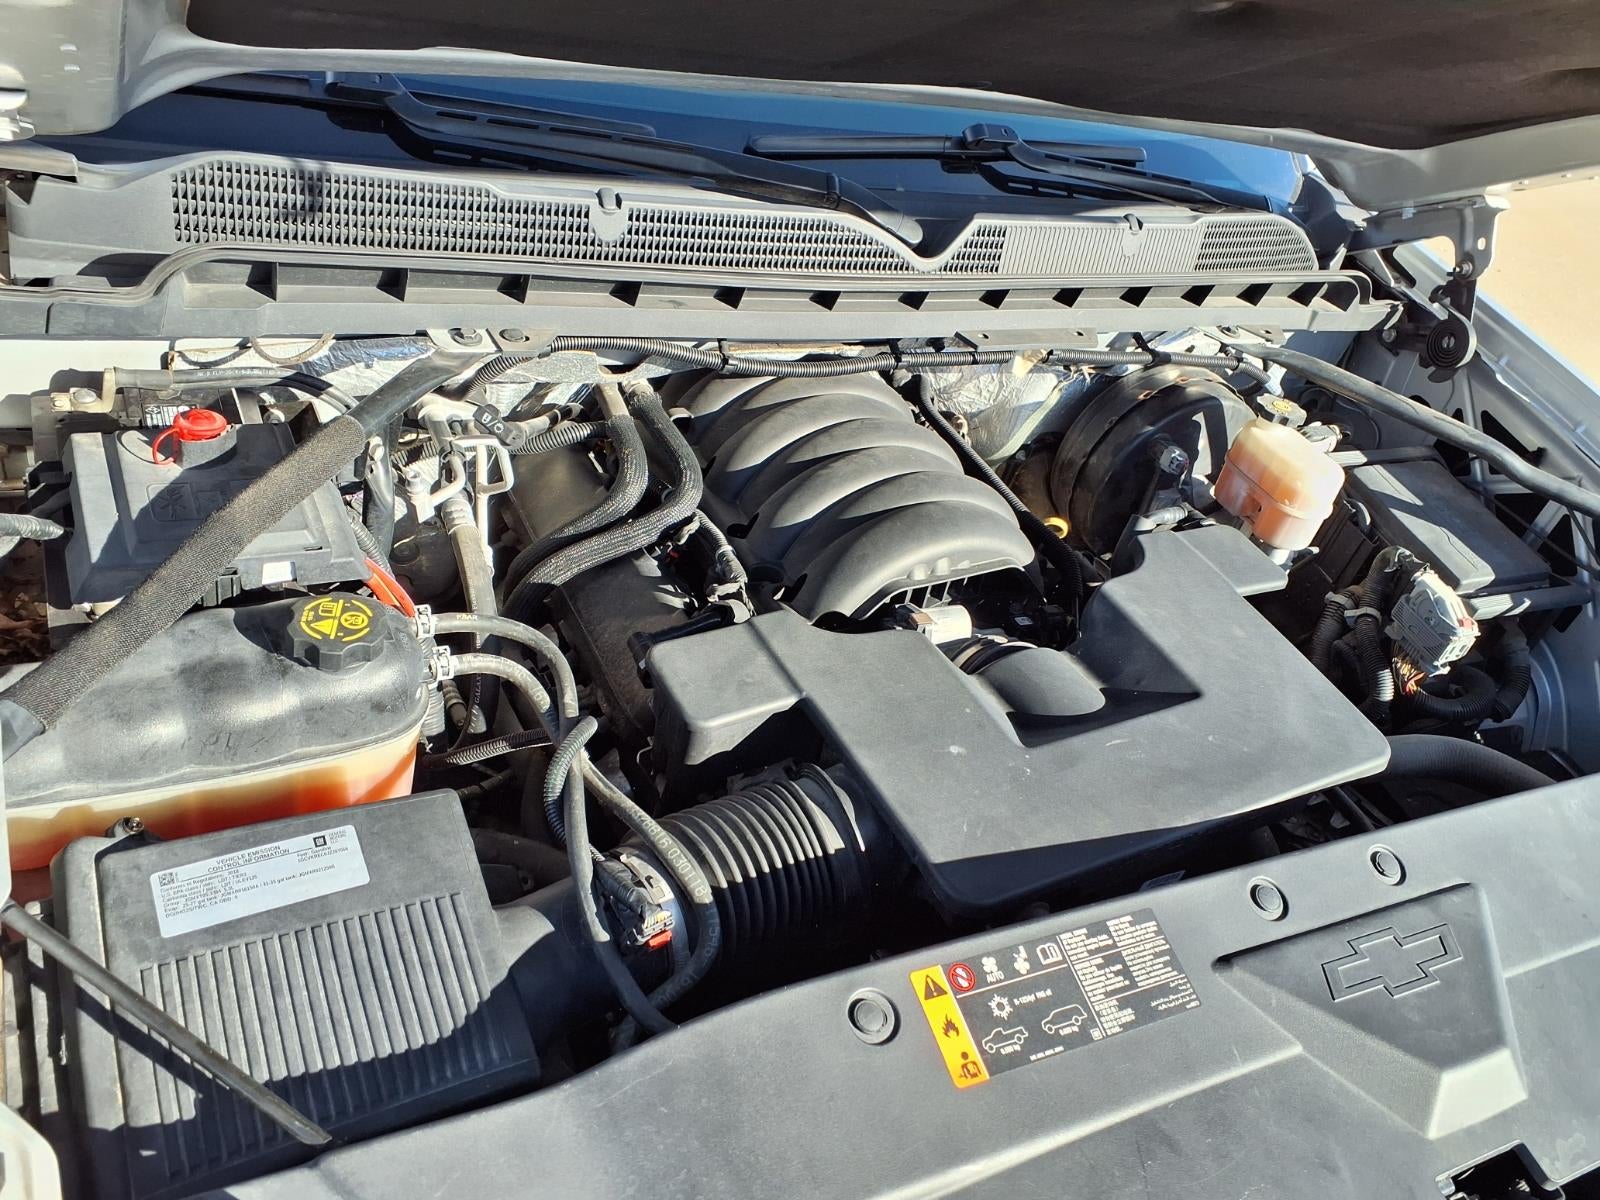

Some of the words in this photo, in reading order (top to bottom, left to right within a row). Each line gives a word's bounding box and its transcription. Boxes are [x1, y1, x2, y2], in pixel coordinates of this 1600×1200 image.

[208, 861, 240, 872] CONTROL
[243, 849, 289, 864] INFORMATION
[216, 854, 245, 864] VEHICLE
[248, 846, 280, 857] EMISSION
